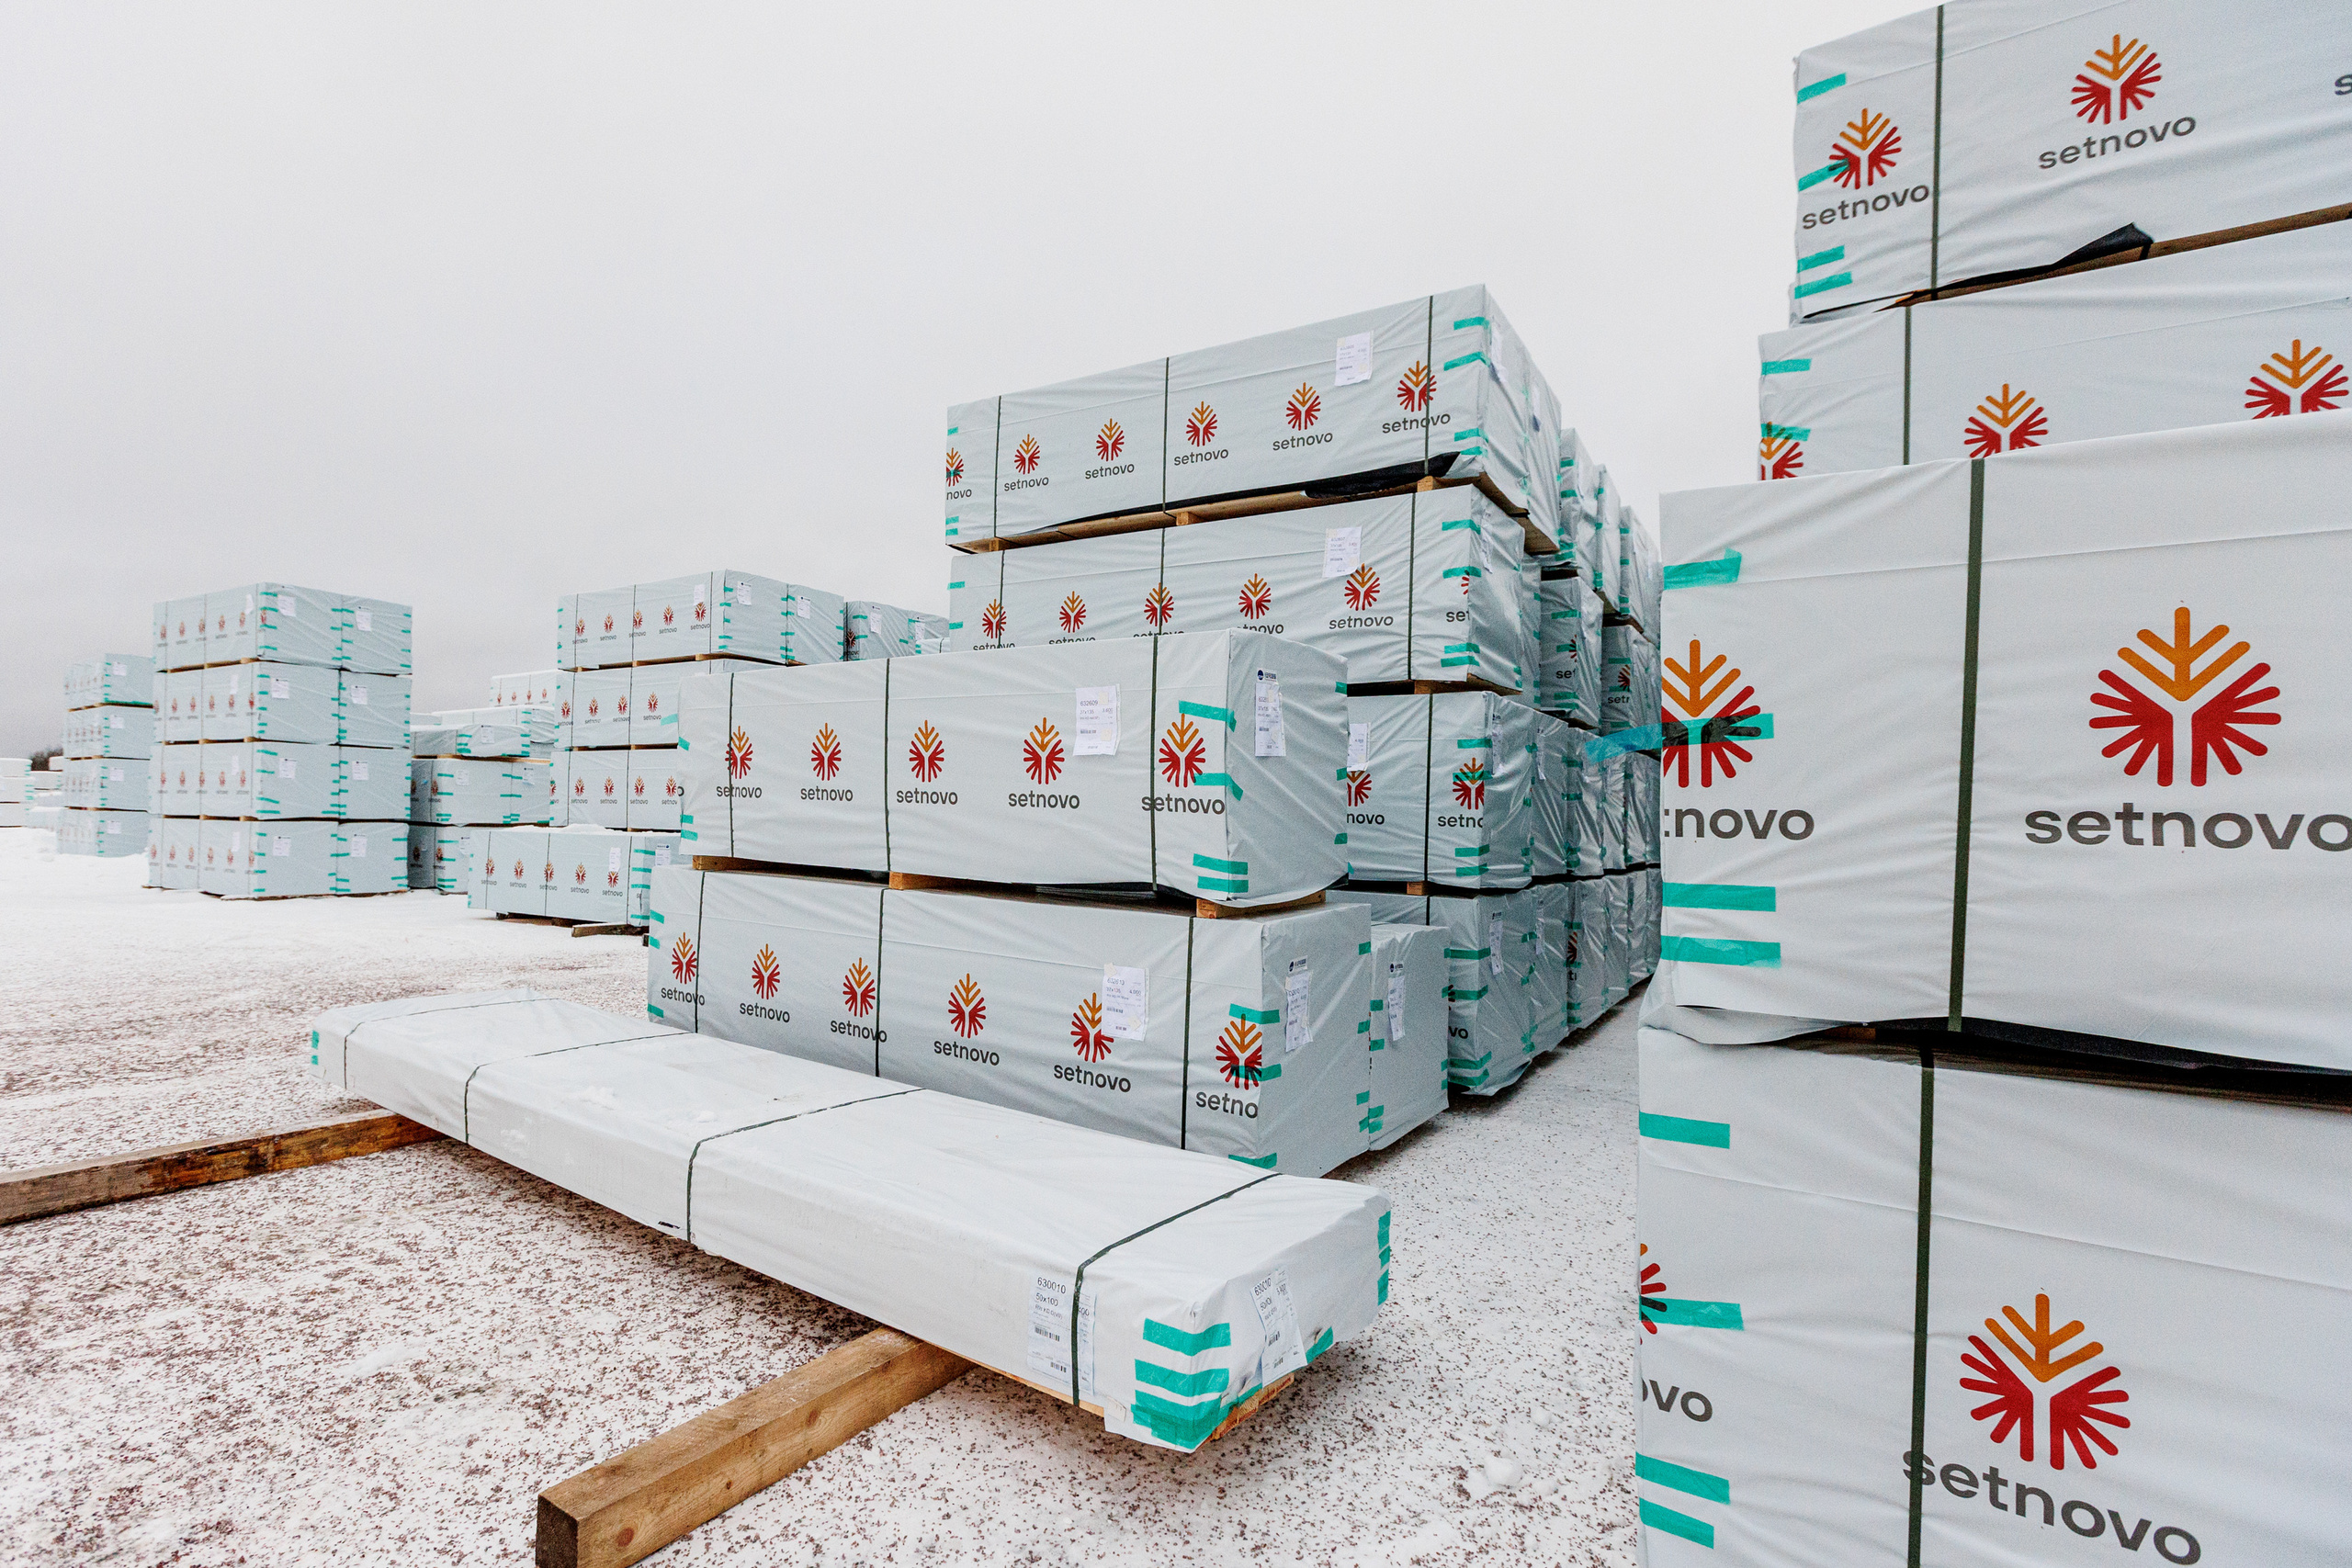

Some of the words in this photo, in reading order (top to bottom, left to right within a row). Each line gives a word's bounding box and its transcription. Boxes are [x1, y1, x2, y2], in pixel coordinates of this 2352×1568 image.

[2039, 116, 2197, 169] setnovo
[1802, 184, 1929, 230] setnovo
[1382, 413, 1451, 434] setnovo
[1272, 432, 1333, 451] setnovo
[1173, 448, 1229, 467] setnovo
[1084, 463, 1135, 479] setnovo
[1003, 476, 1049, 491] setnovo
[690, 623, 710, 631] setnovo
[1329, 615, 1394, 629] setnovo
[716, 784, 763, 798] setnovo
[800, 785, 854, 801] setnovo
[896, 787, 958, 805] setnovo
[1008, 790, 1080, 809] setnovo
[1141, 794, 1226, 815] setnovo
[1664, 807, 1815, 841] novo
[2025, 803, 2352, 852] setnovo
[602, 888, 624, 897] setnovo
[661, 987, 706, 1006] setnovo
[739, 1002, 791, 1023] setnovo
[830, 1020, 888, 1043] setnovo
[933, 1040, 1001, 1066] setnovo
[1053, 1064, 1132, 1093] setnovo
[1037, 1277, 1067, 1294] 630010
[1035, 1292, 1059, 1306] 50x100
[1641, 1377, 1713, 1423] vo
[1903, 1450, 2202, 1566] setnovo
